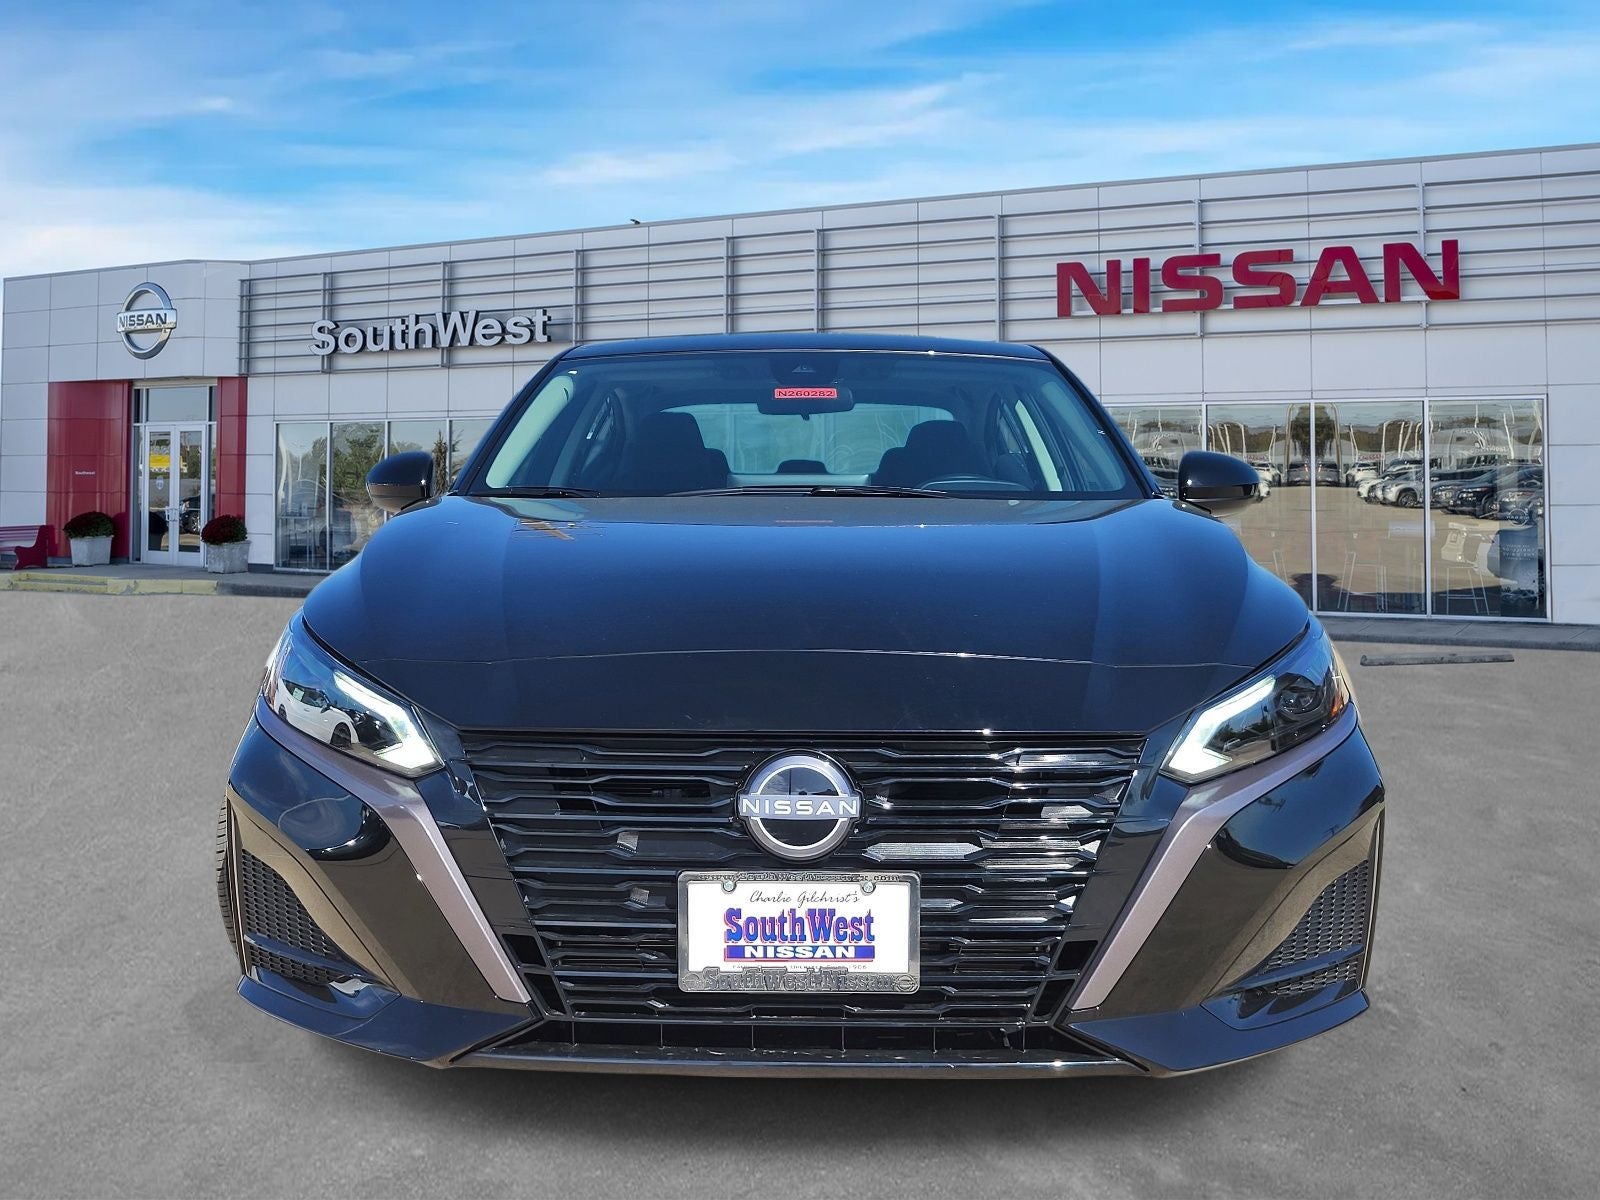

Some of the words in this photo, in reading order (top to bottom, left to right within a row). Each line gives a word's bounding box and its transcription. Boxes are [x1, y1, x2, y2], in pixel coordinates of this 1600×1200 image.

[1056, 239, 1461, 319] NISSAN
[119, 312, 167, 329] NISSAN
[309, 308, 551, 356] SouthWest
[742, 798, 857, 816] NISSAN
[750, 890, 792, 903] Charlie
[797, 890, 860, 908] Gilchrist's
[723, 907, 875, 943] SouthWest
[744, 945, 856, 958] NISSAN
